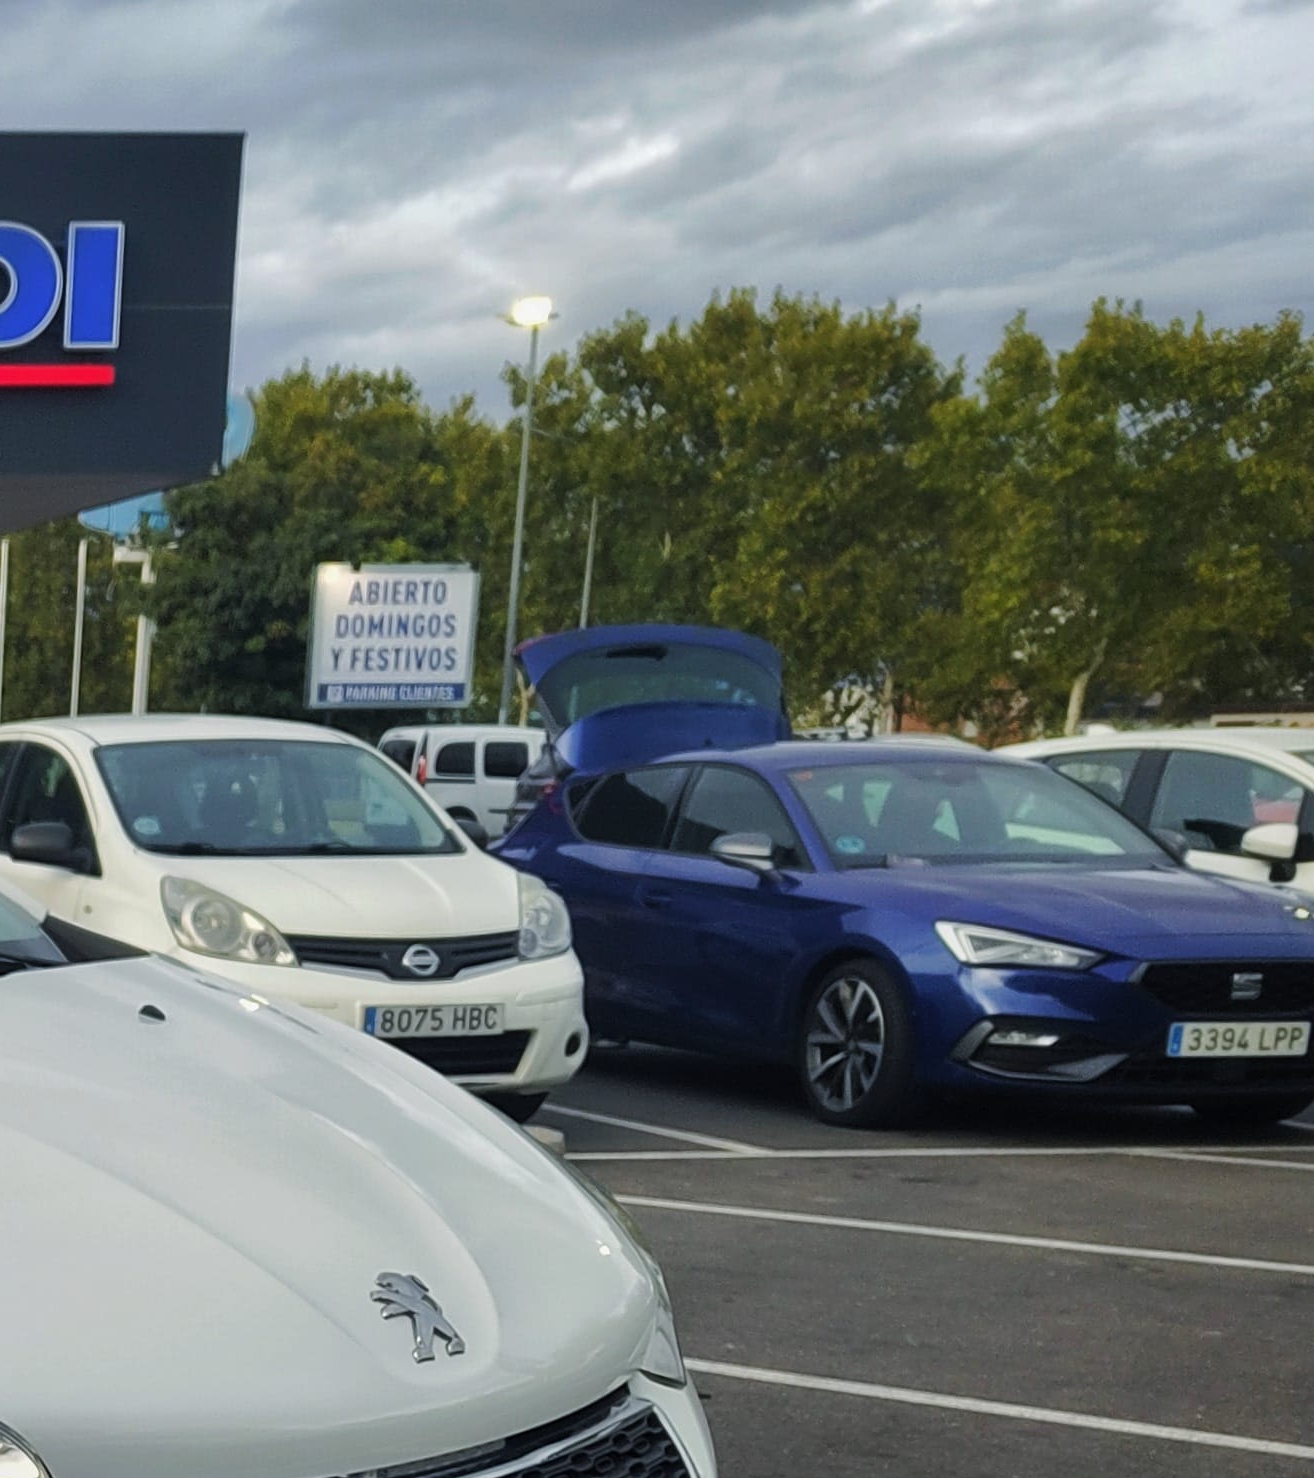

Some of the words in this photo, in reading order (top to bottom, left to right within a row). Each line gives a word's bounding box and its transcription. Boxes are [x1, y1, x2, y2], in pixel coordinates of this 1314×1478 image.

[348, 580, 447, 605] ABIERTO
[335, 614, 457, 639] DOMINGOS
[331, 648, 343, 671] Y
[350, 647, 457, 671] FESTIVOS
[380, 1006, 443, 1033] 8075
[451, 1006, 498, 1030] HBC
[1188, 1027, 1249, 1051] 3394
[1259, 1026, 1304, 1051] LPP
